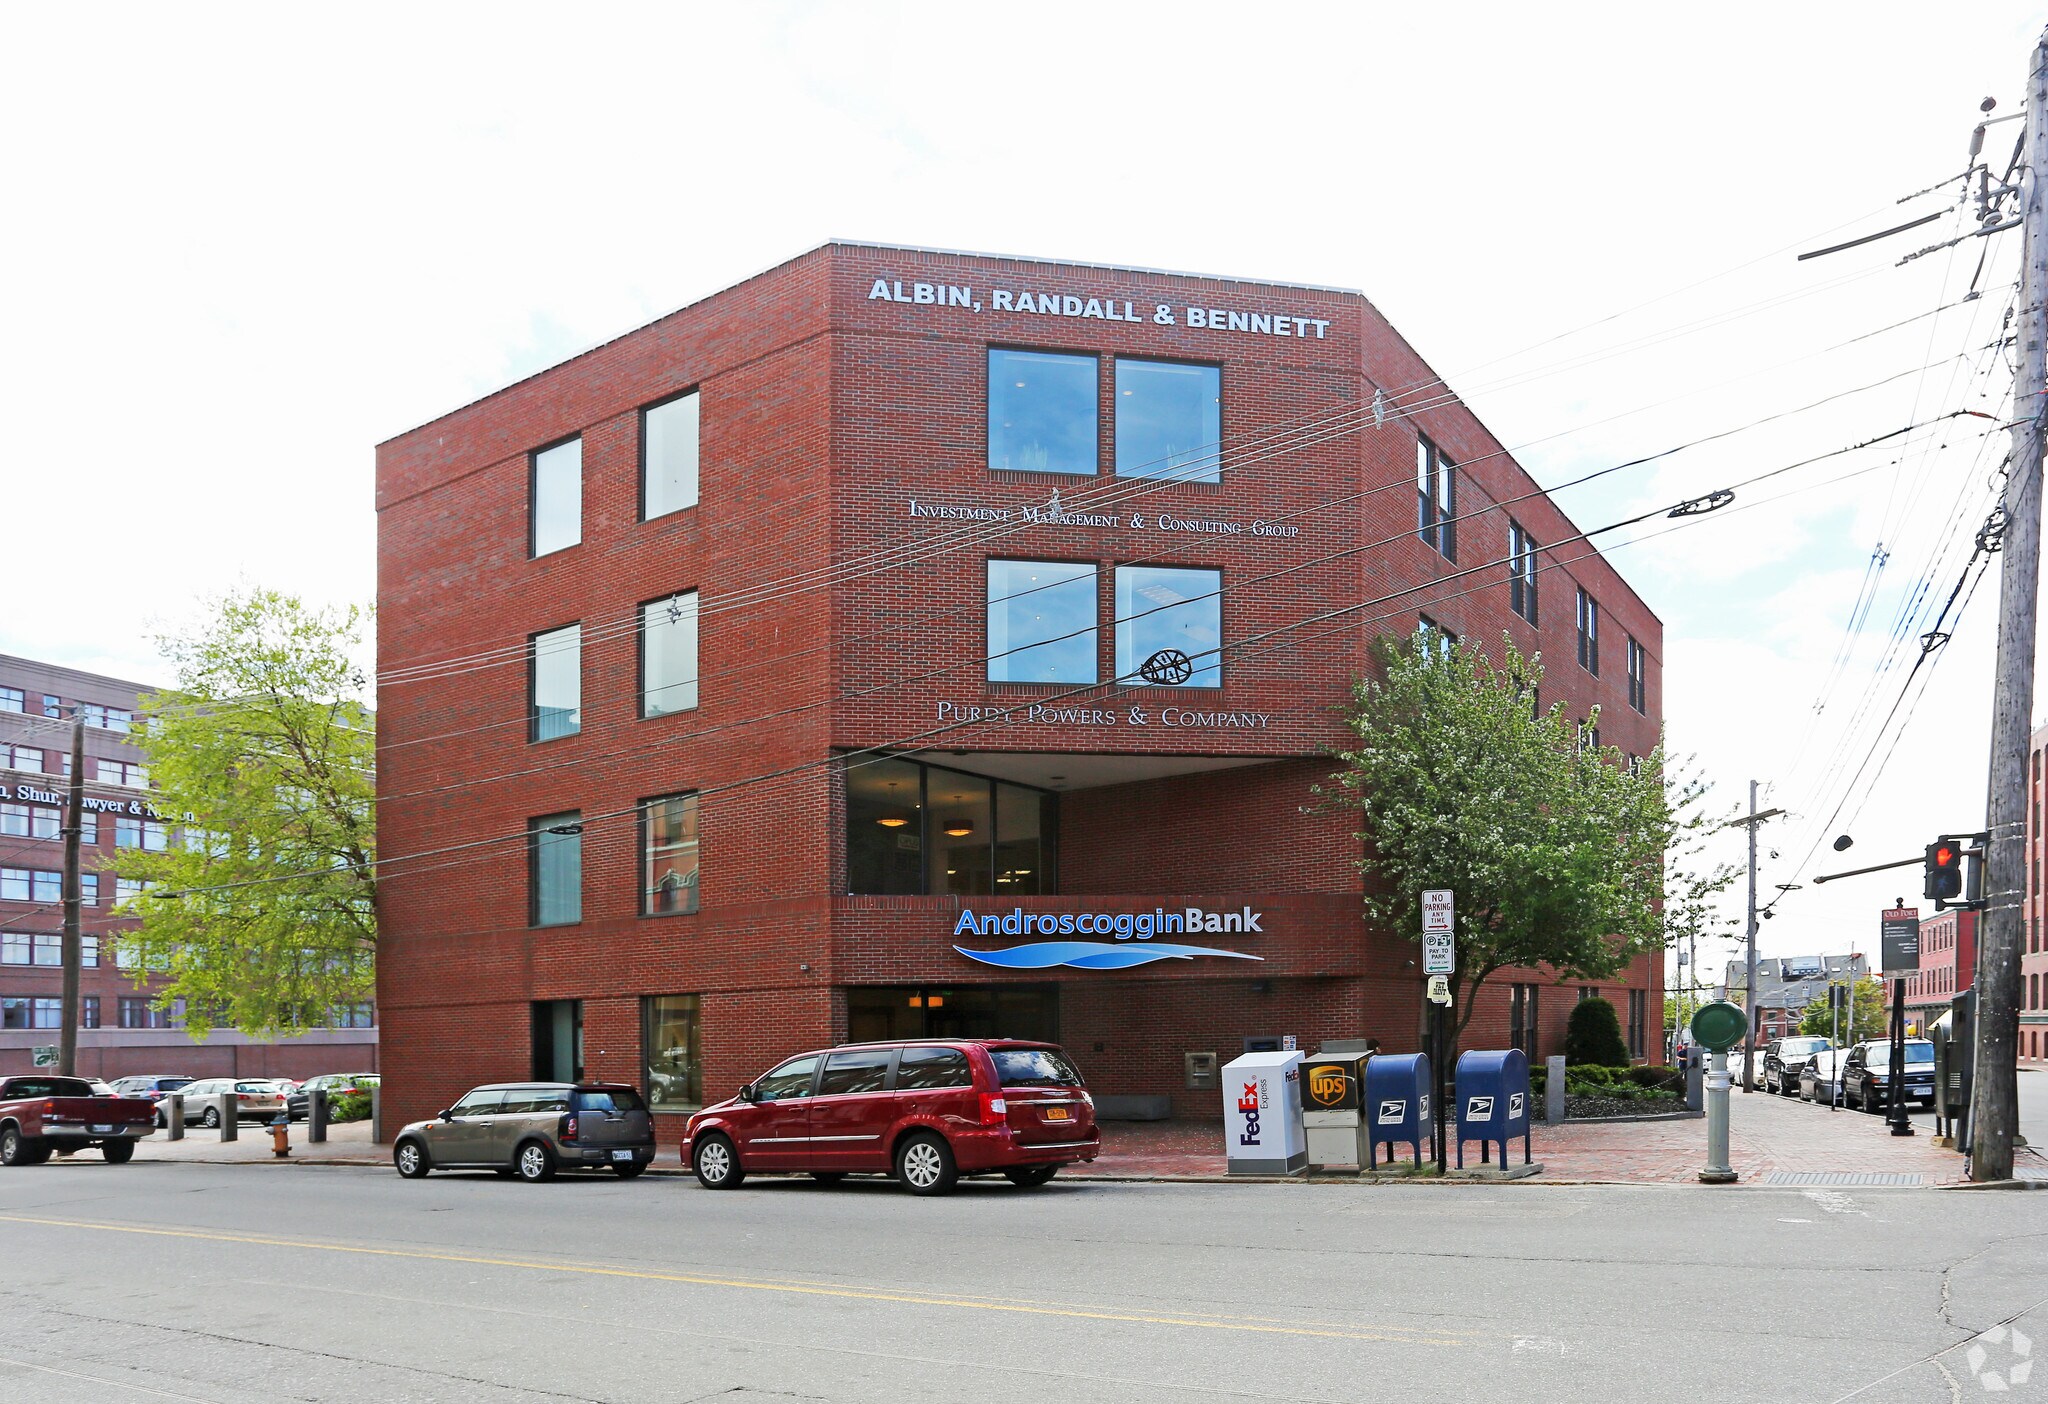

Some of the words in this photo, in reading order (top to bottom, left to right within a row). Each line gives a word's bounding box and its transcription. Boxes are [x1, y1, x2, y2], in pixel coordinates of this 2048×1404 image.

[868, 279, 981, 314] ALBIN,
[992, 289, 1142, 323] RANDALL
[1153, 304, 1176, 326] &
[1187, 307, 1330, 340] BENNETT
[909, 500, 1011, 522] INVESTMENT
[1130, 513, 1145, 529] &
[1158, 514, 1241, 534] CONSULTING
[1252, 520, 1299, 538] GROUP
[1027, 704, 1116, 726] POWERS
[1128, 706, 1148, 725] &
[1161, 707, 1271, 728] COMPANY
[17, 785, 62, 806] Shur,
[128, 800, 142, 815] &
[1425, 903, 1451, 911] PARKING
[1432, 894, 1443, 902] NO
[1260, 1079, 1269, 1109] Express
[1312, 1078, 1344, 1100] ups
[1238, 1083, 1260, 1145] FedEx
